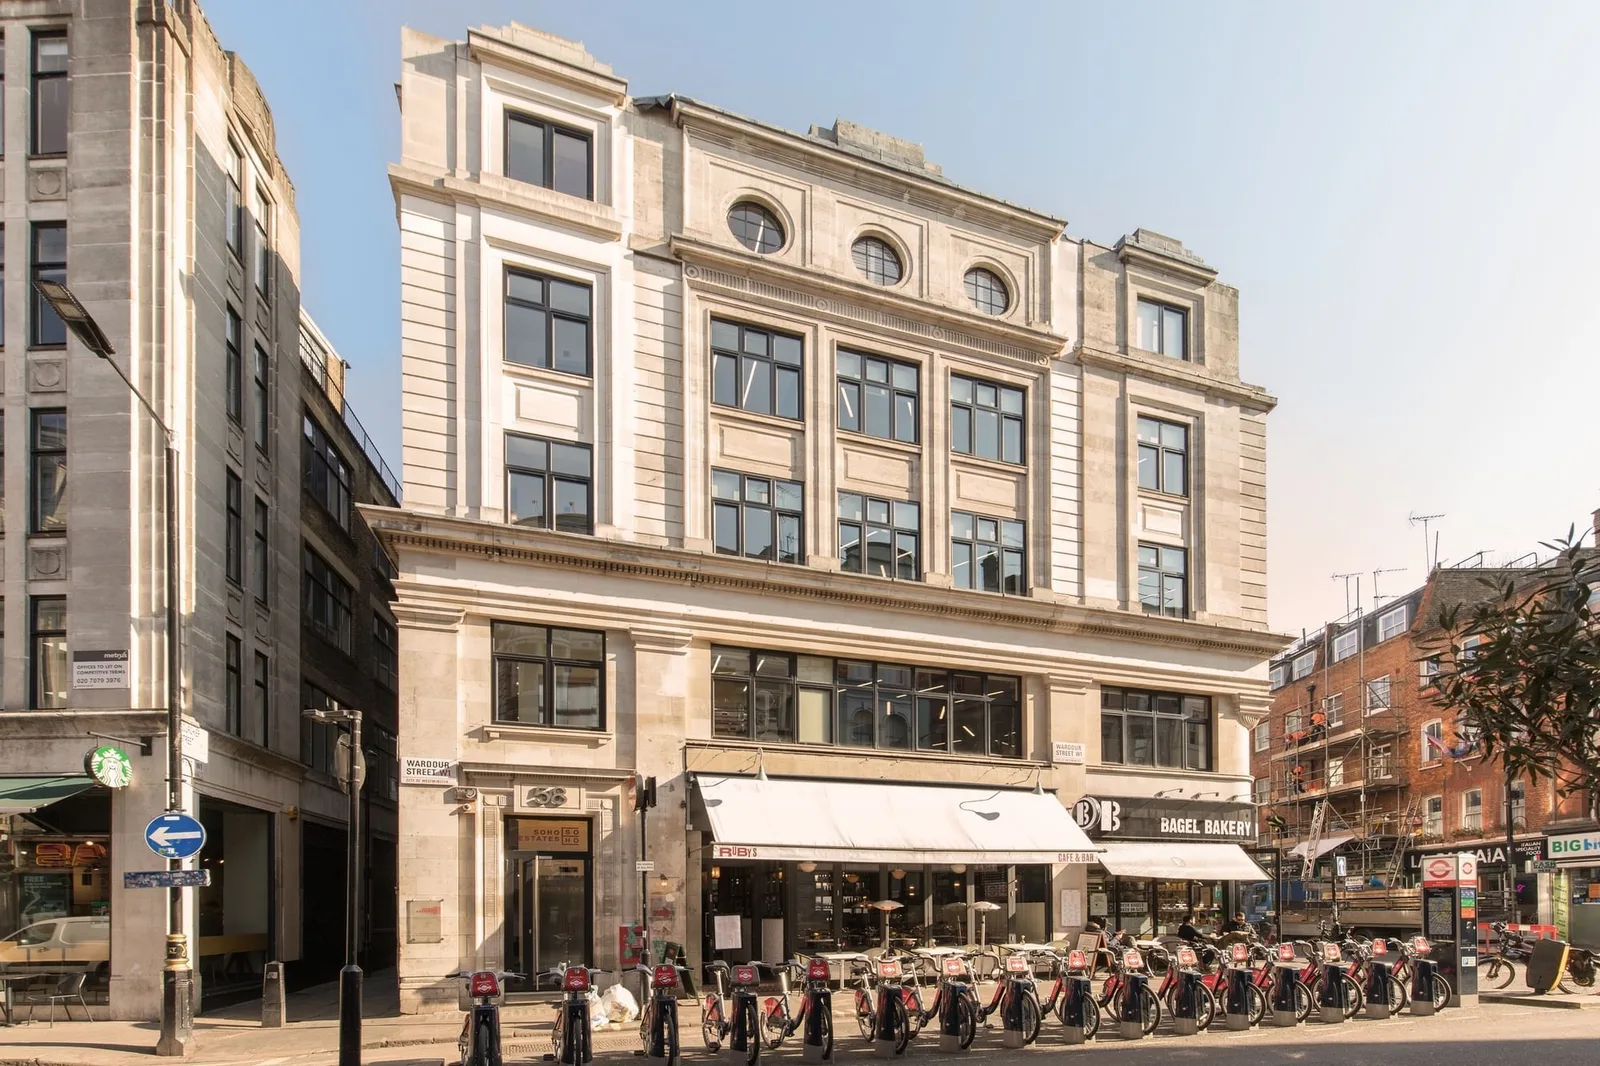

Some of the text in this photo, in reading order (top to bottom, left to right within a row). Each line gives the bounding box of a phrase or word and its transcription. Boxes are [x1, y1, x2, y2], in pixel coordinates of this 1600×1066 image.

[1055, 743, 1082, 751] WARDOUR
[406, 759, 450, 768] WARDOUR
[406, 767, 451, 777] STREET W1
[534, 785, 568, 806] 58
[1160, 816, 1200, 834] BAGEL
[1204, 819, 1251, 836] BAKERY
[1552, 839, 1582, 853] BIG
[1057, 852, 1095, 863] CAFE & BAR
